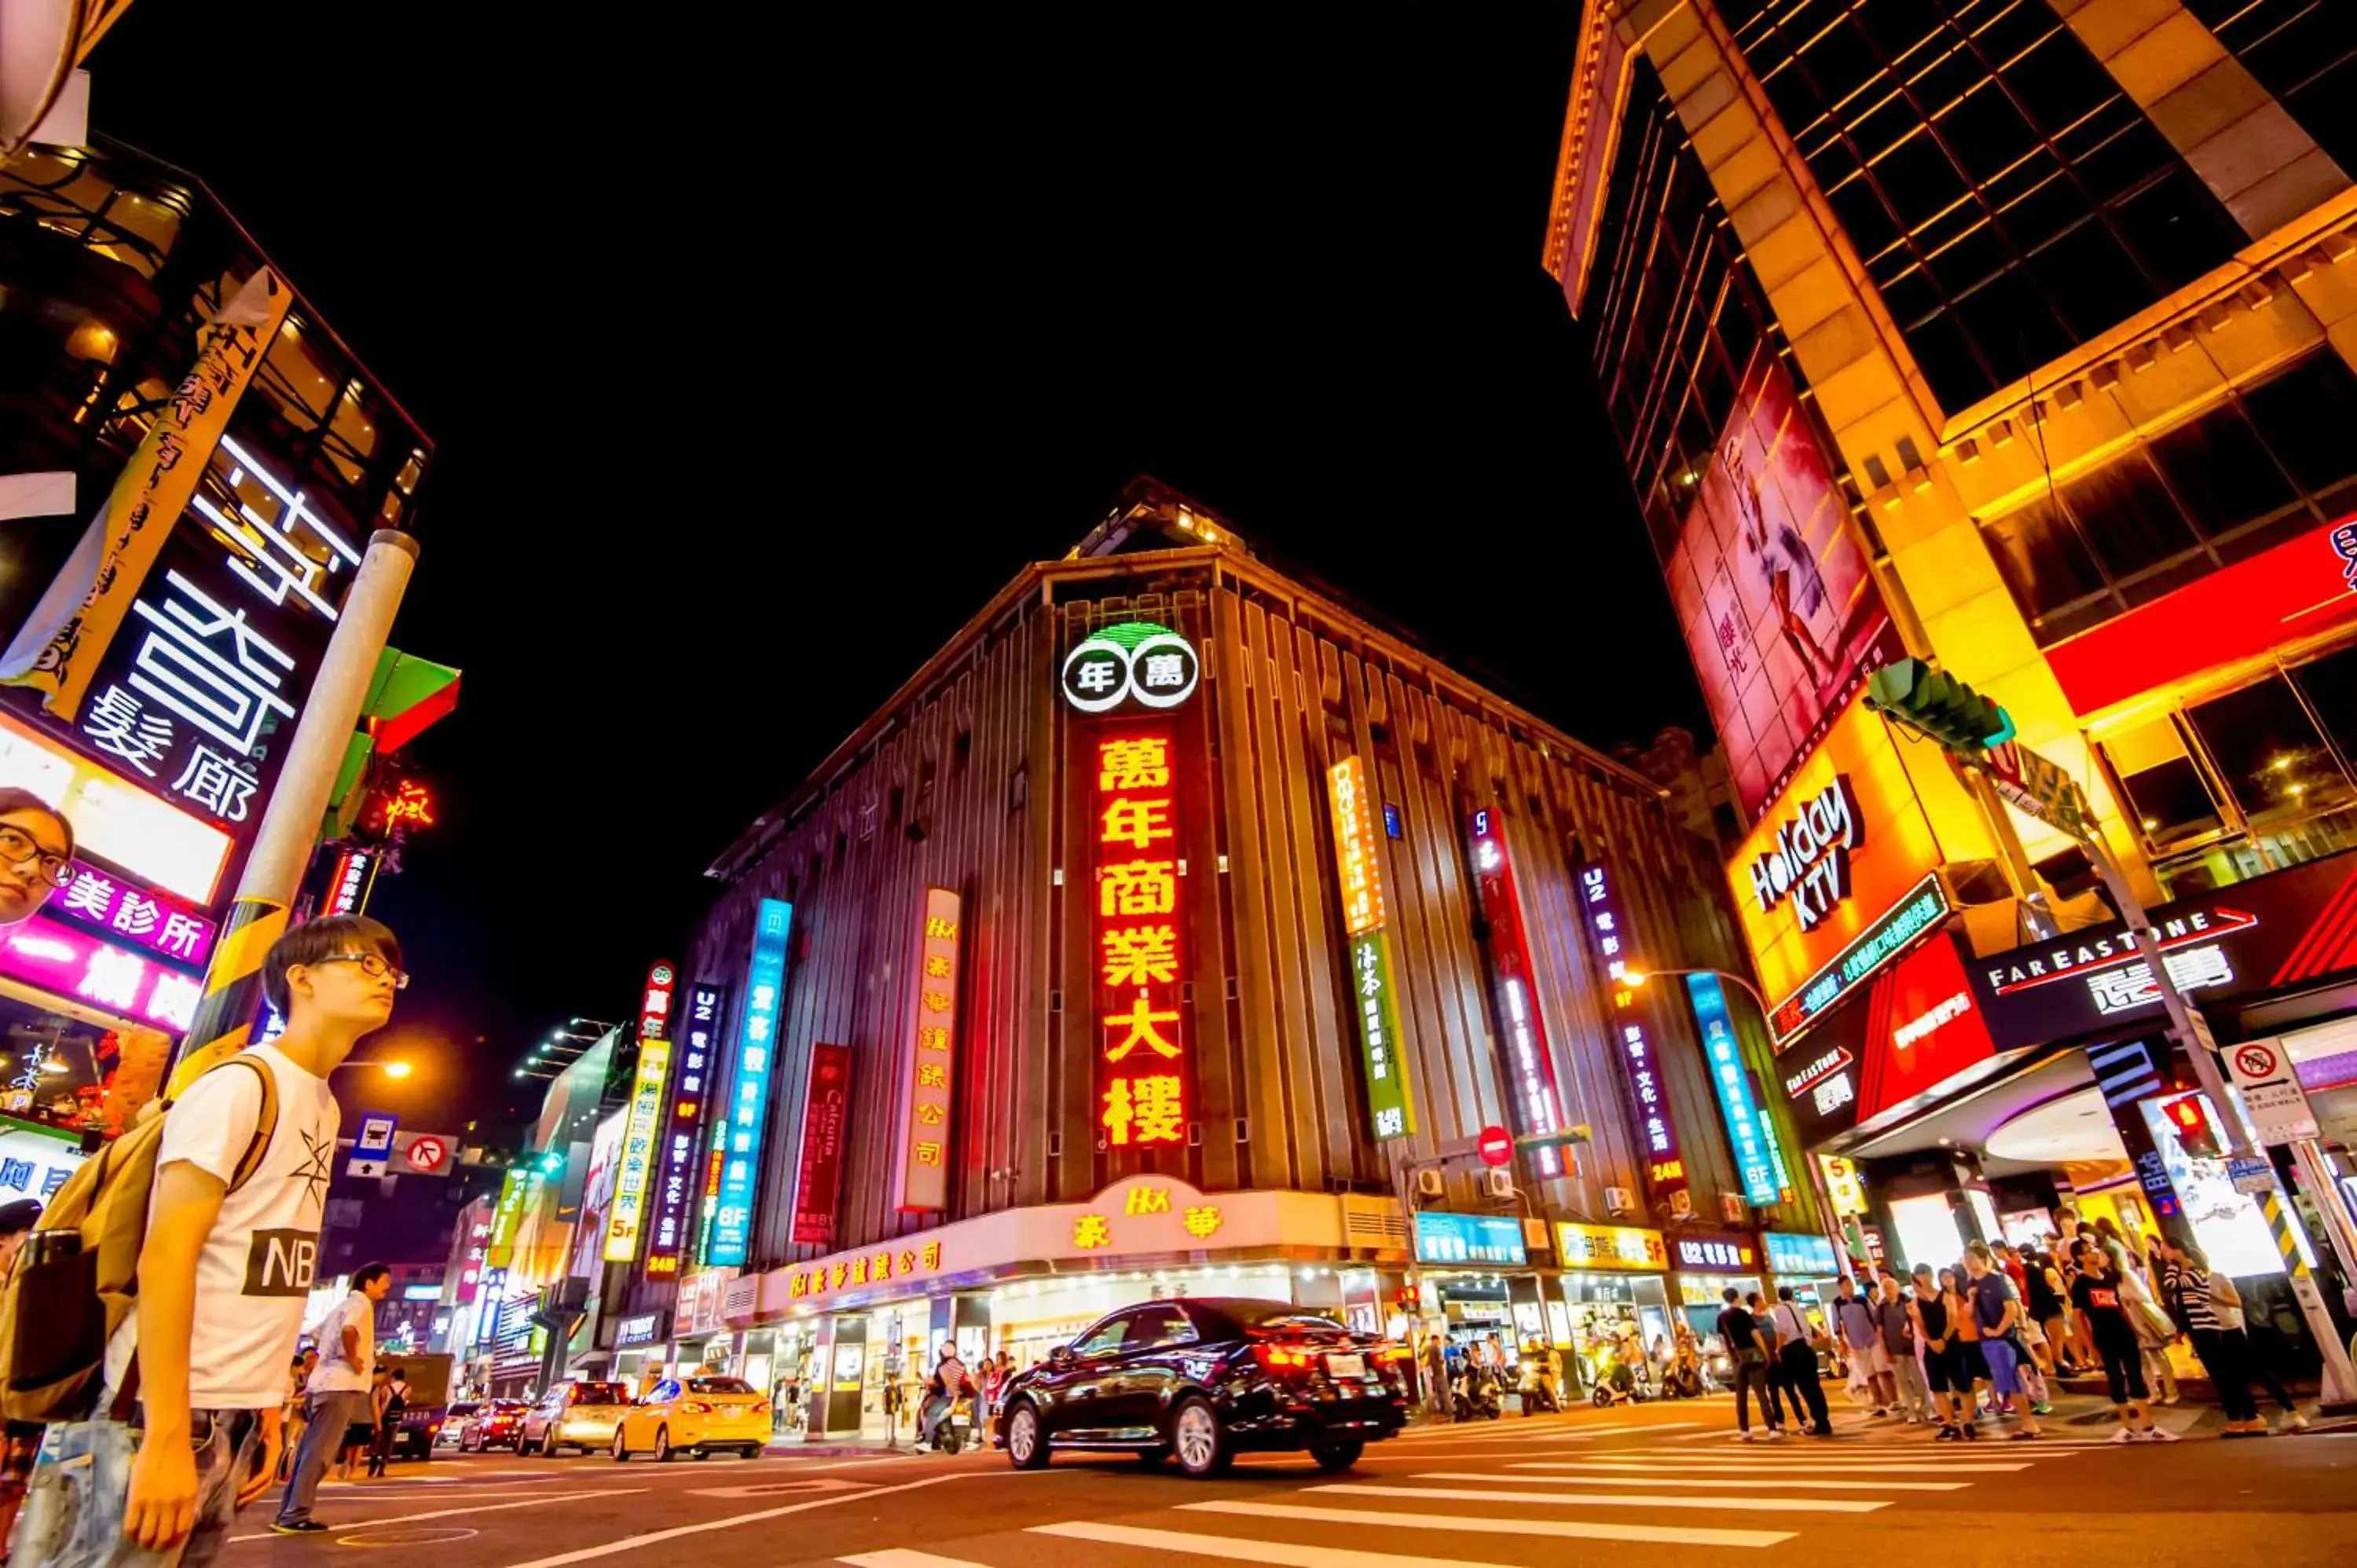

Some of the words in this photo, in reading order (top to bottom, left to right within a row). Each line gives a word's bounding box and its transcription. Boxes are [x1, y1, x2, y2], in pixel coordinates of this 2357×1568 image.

[84, 683, 258, 822] 髮廊
[1750, 779, 1855, 911] Holiday
[1791, 844, 1847, 932] KTV
[1099, 737, 1185, 1146] 萬年商業大樓
[611, 1219, 636, 1239] 5F
